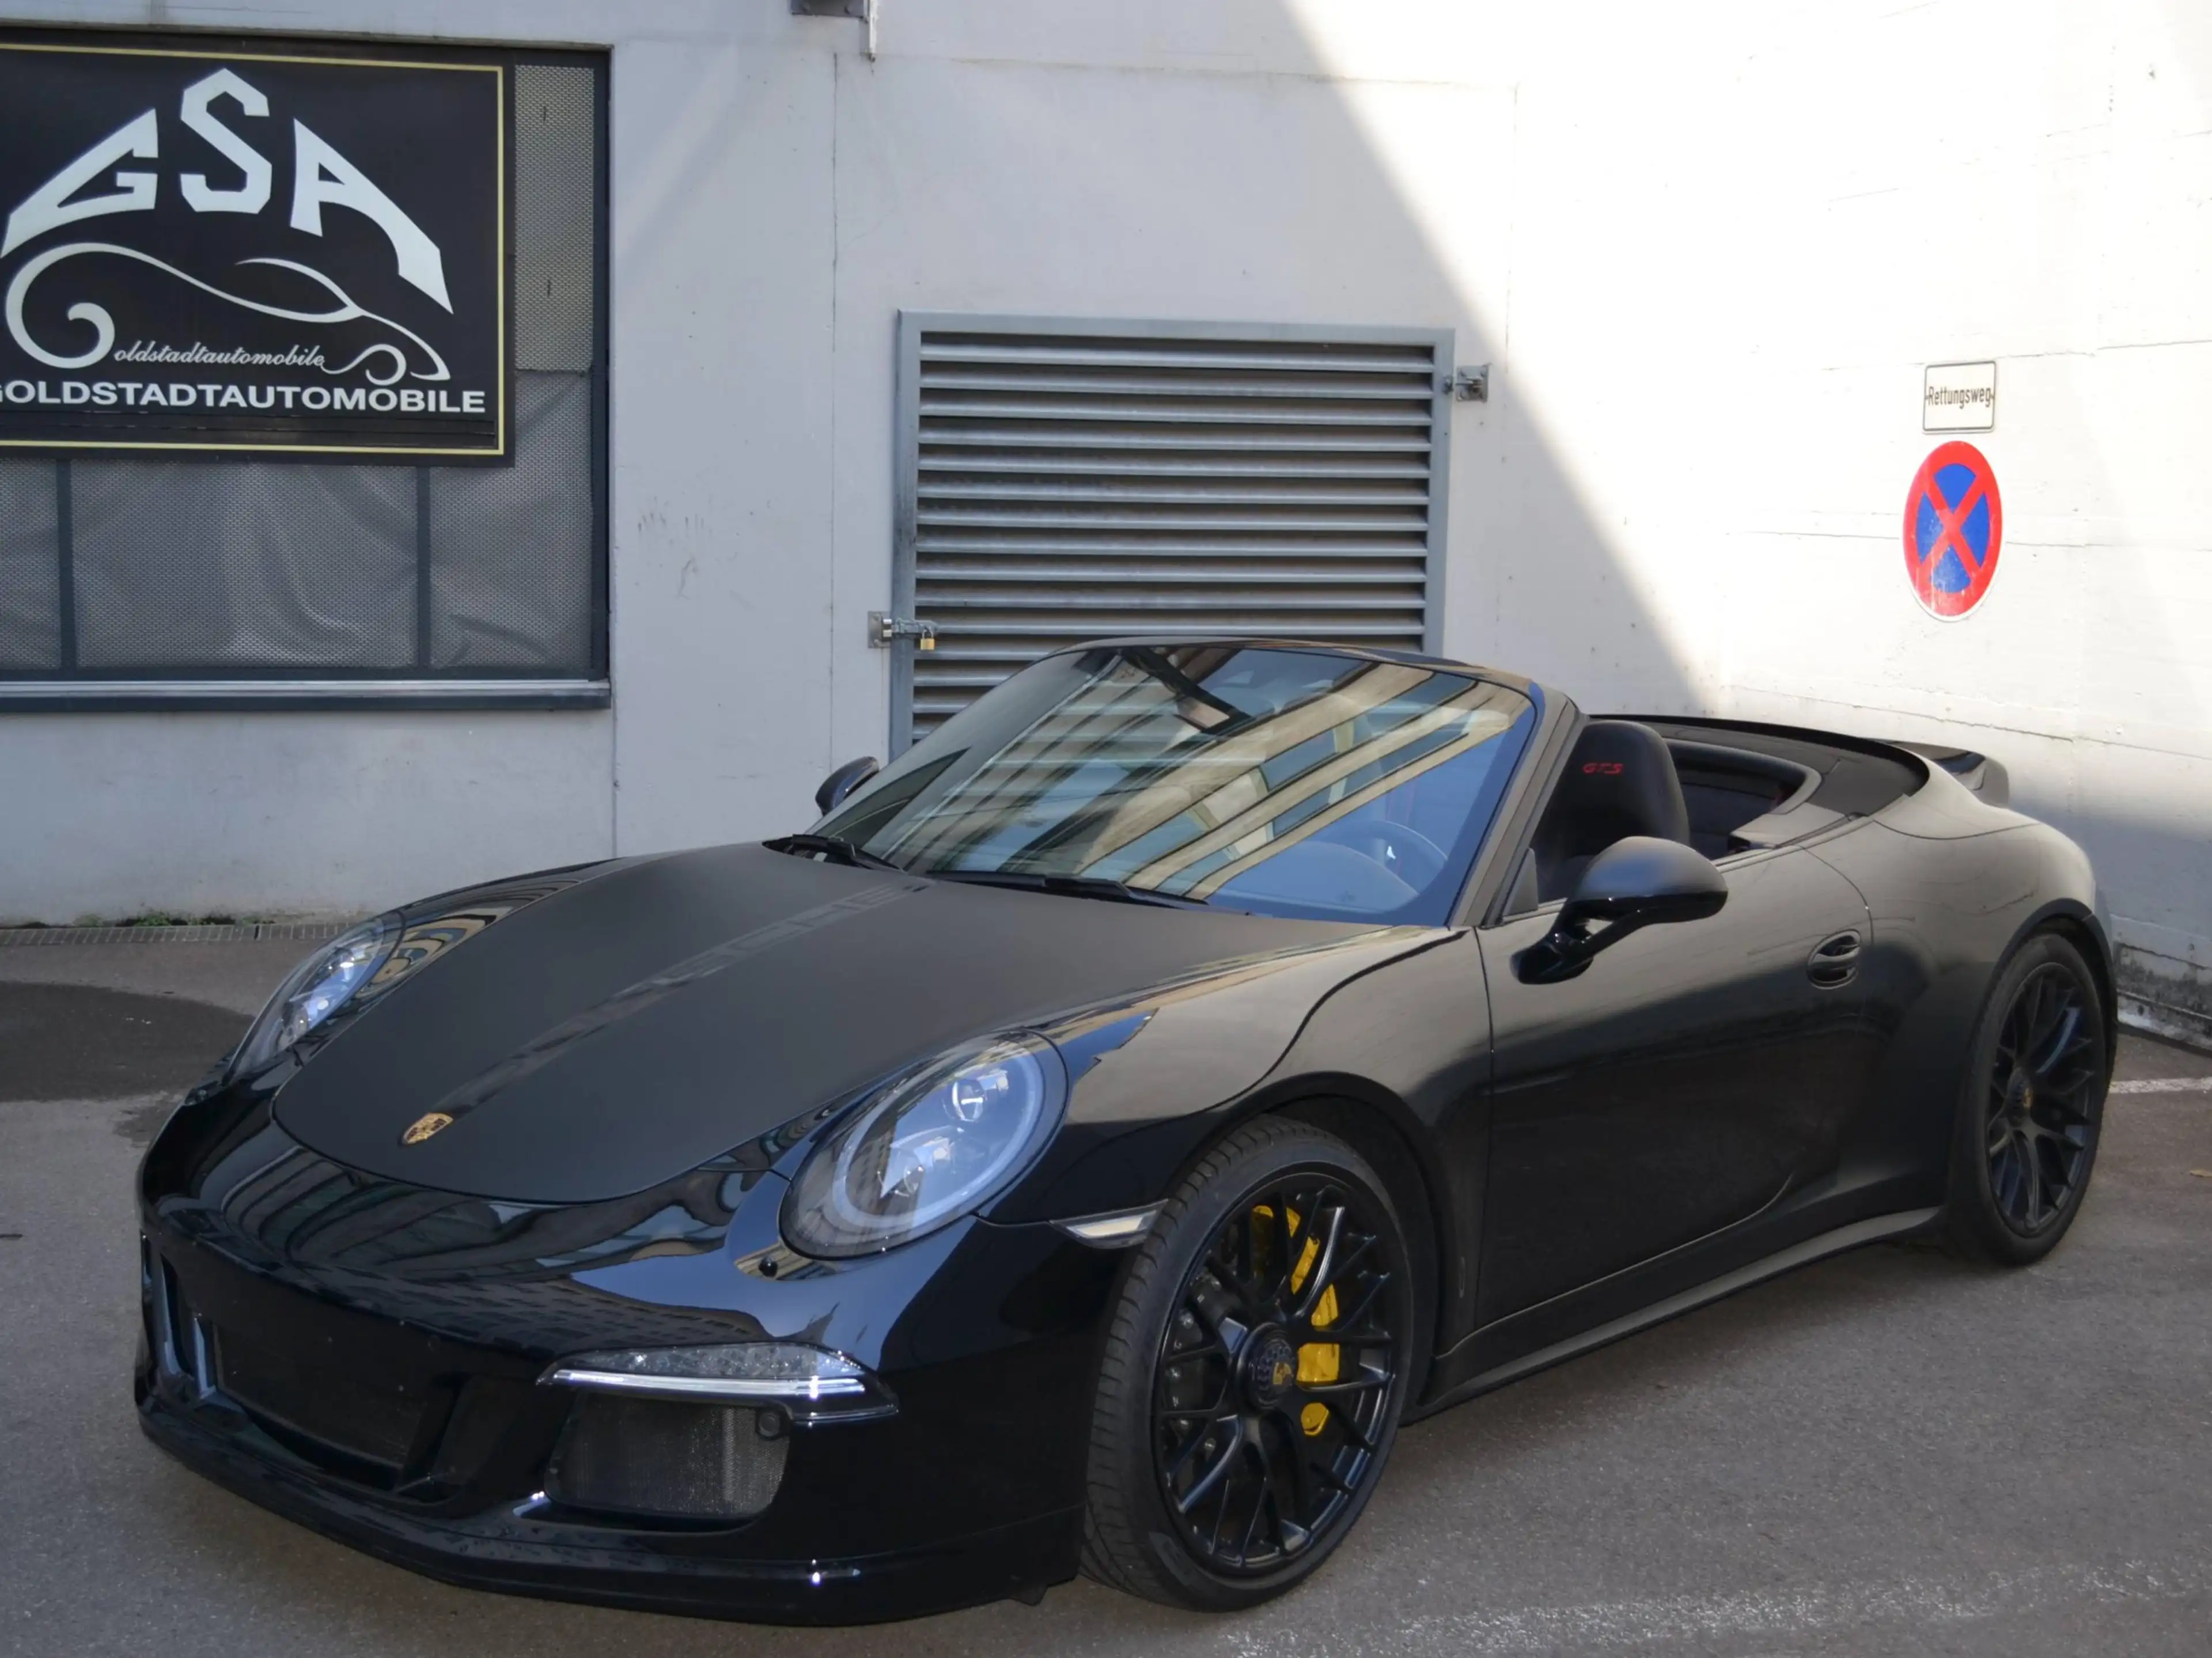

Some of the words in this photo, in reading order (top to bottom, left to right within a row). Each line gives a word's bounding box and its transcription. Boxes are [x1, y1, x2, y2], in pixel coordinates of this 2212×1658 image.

[1, 68, 453, 314] GSA
[0, 380, 486, 413] OLDSTADTAUTOMOBILE
[1927, 385, 1991, 409] Rettungsweg
[1582, 762, 1623, 775] GTS
